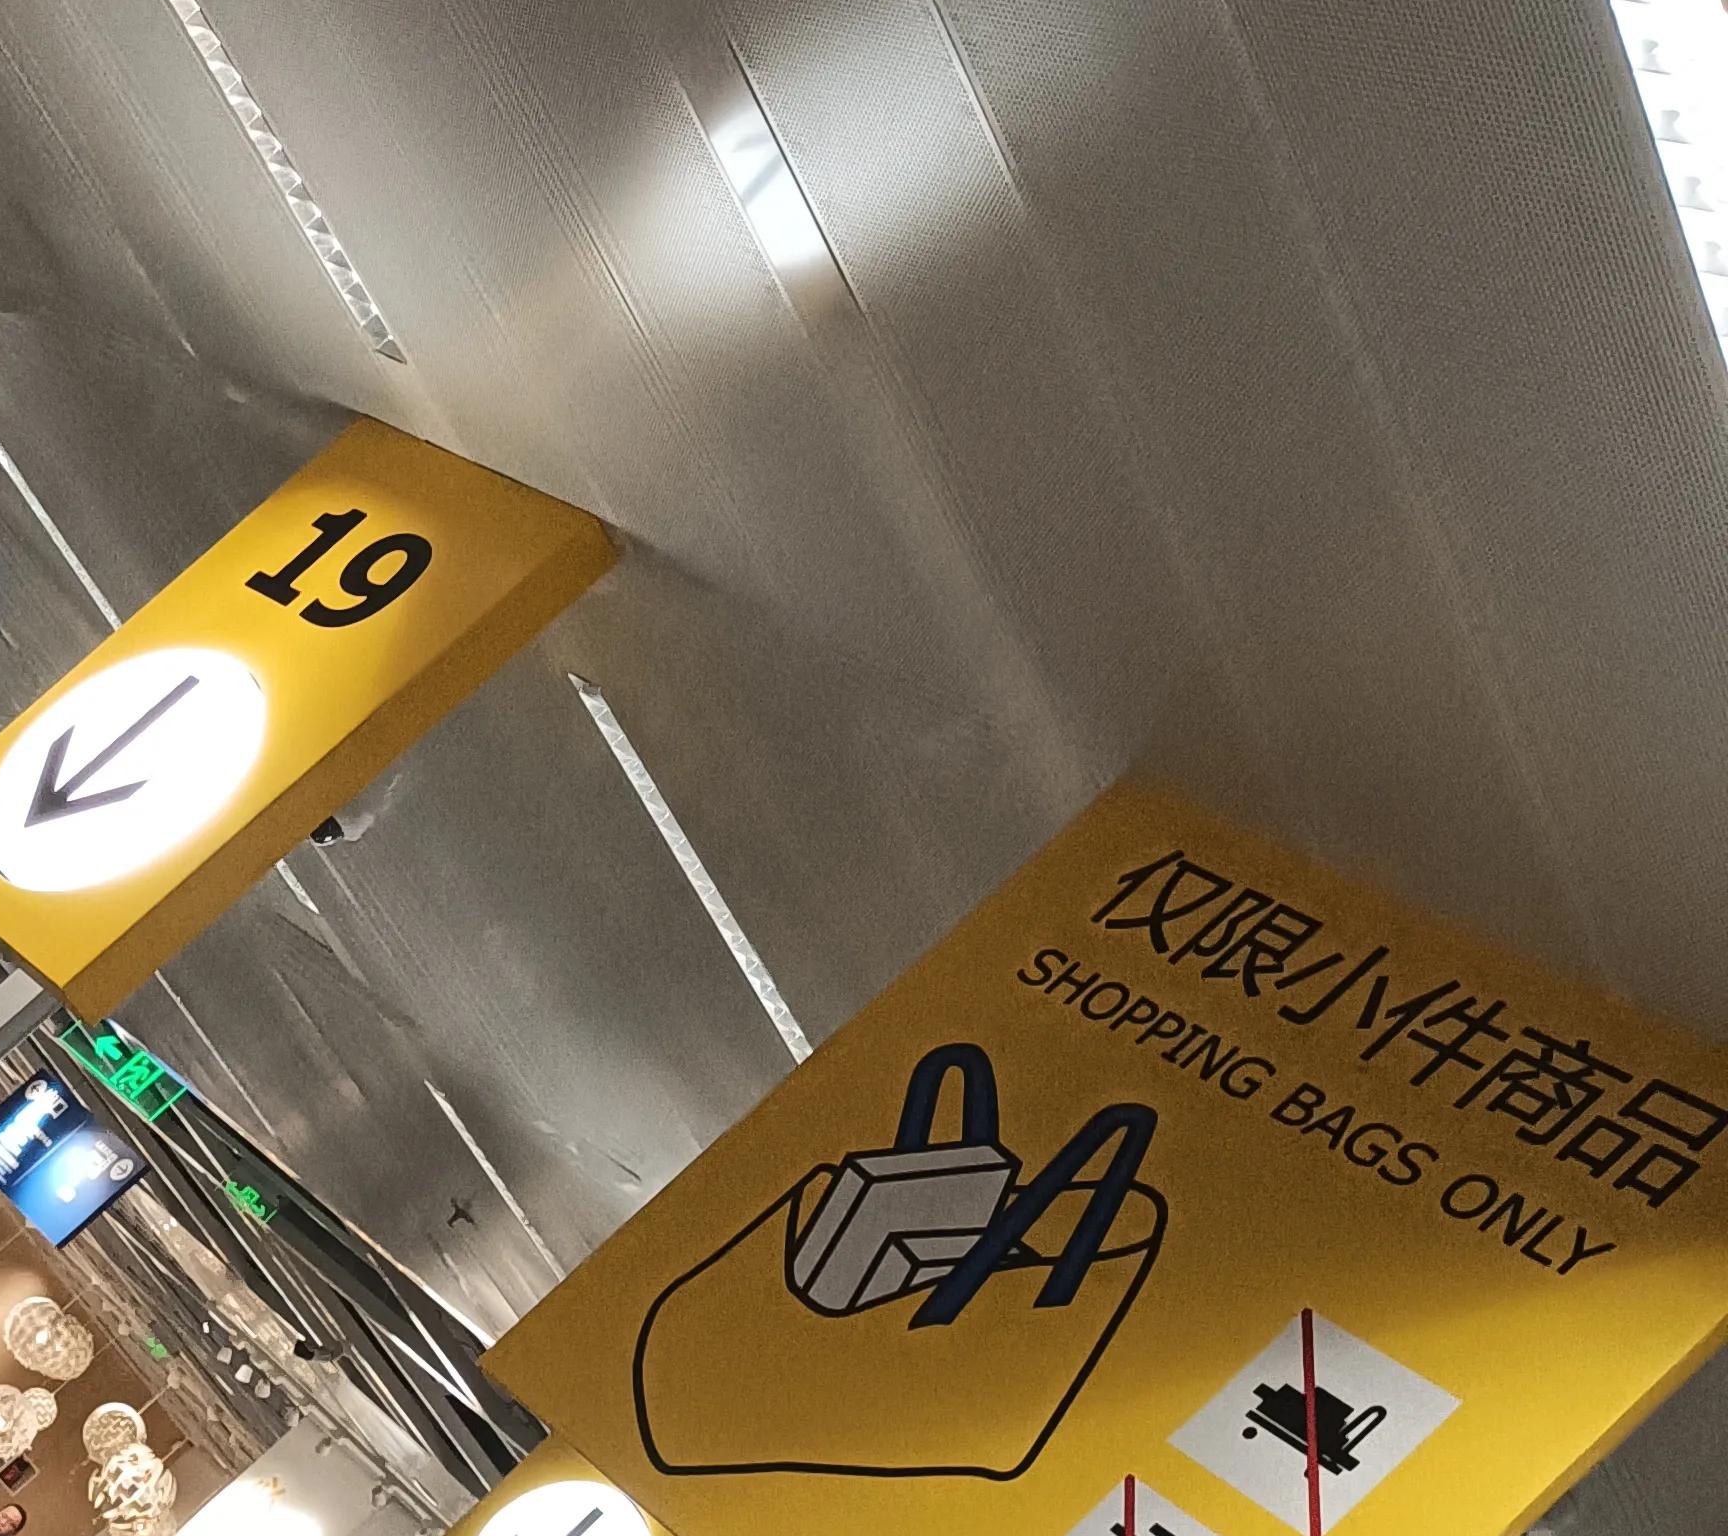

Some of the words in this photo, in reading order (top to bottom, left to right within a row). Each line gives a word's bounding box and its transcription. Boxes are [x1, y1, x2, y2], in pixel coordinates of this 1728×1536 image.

[245, 508, 433, 627] 19
[1015, 946, 1276, 1100] SHOPPING
[1270, 1085, 1440, 1187] BAGS
[1439, 1173, 1618, 1277] ONLY
[1092, 850, 1727, 1208] 仅限小件商品
